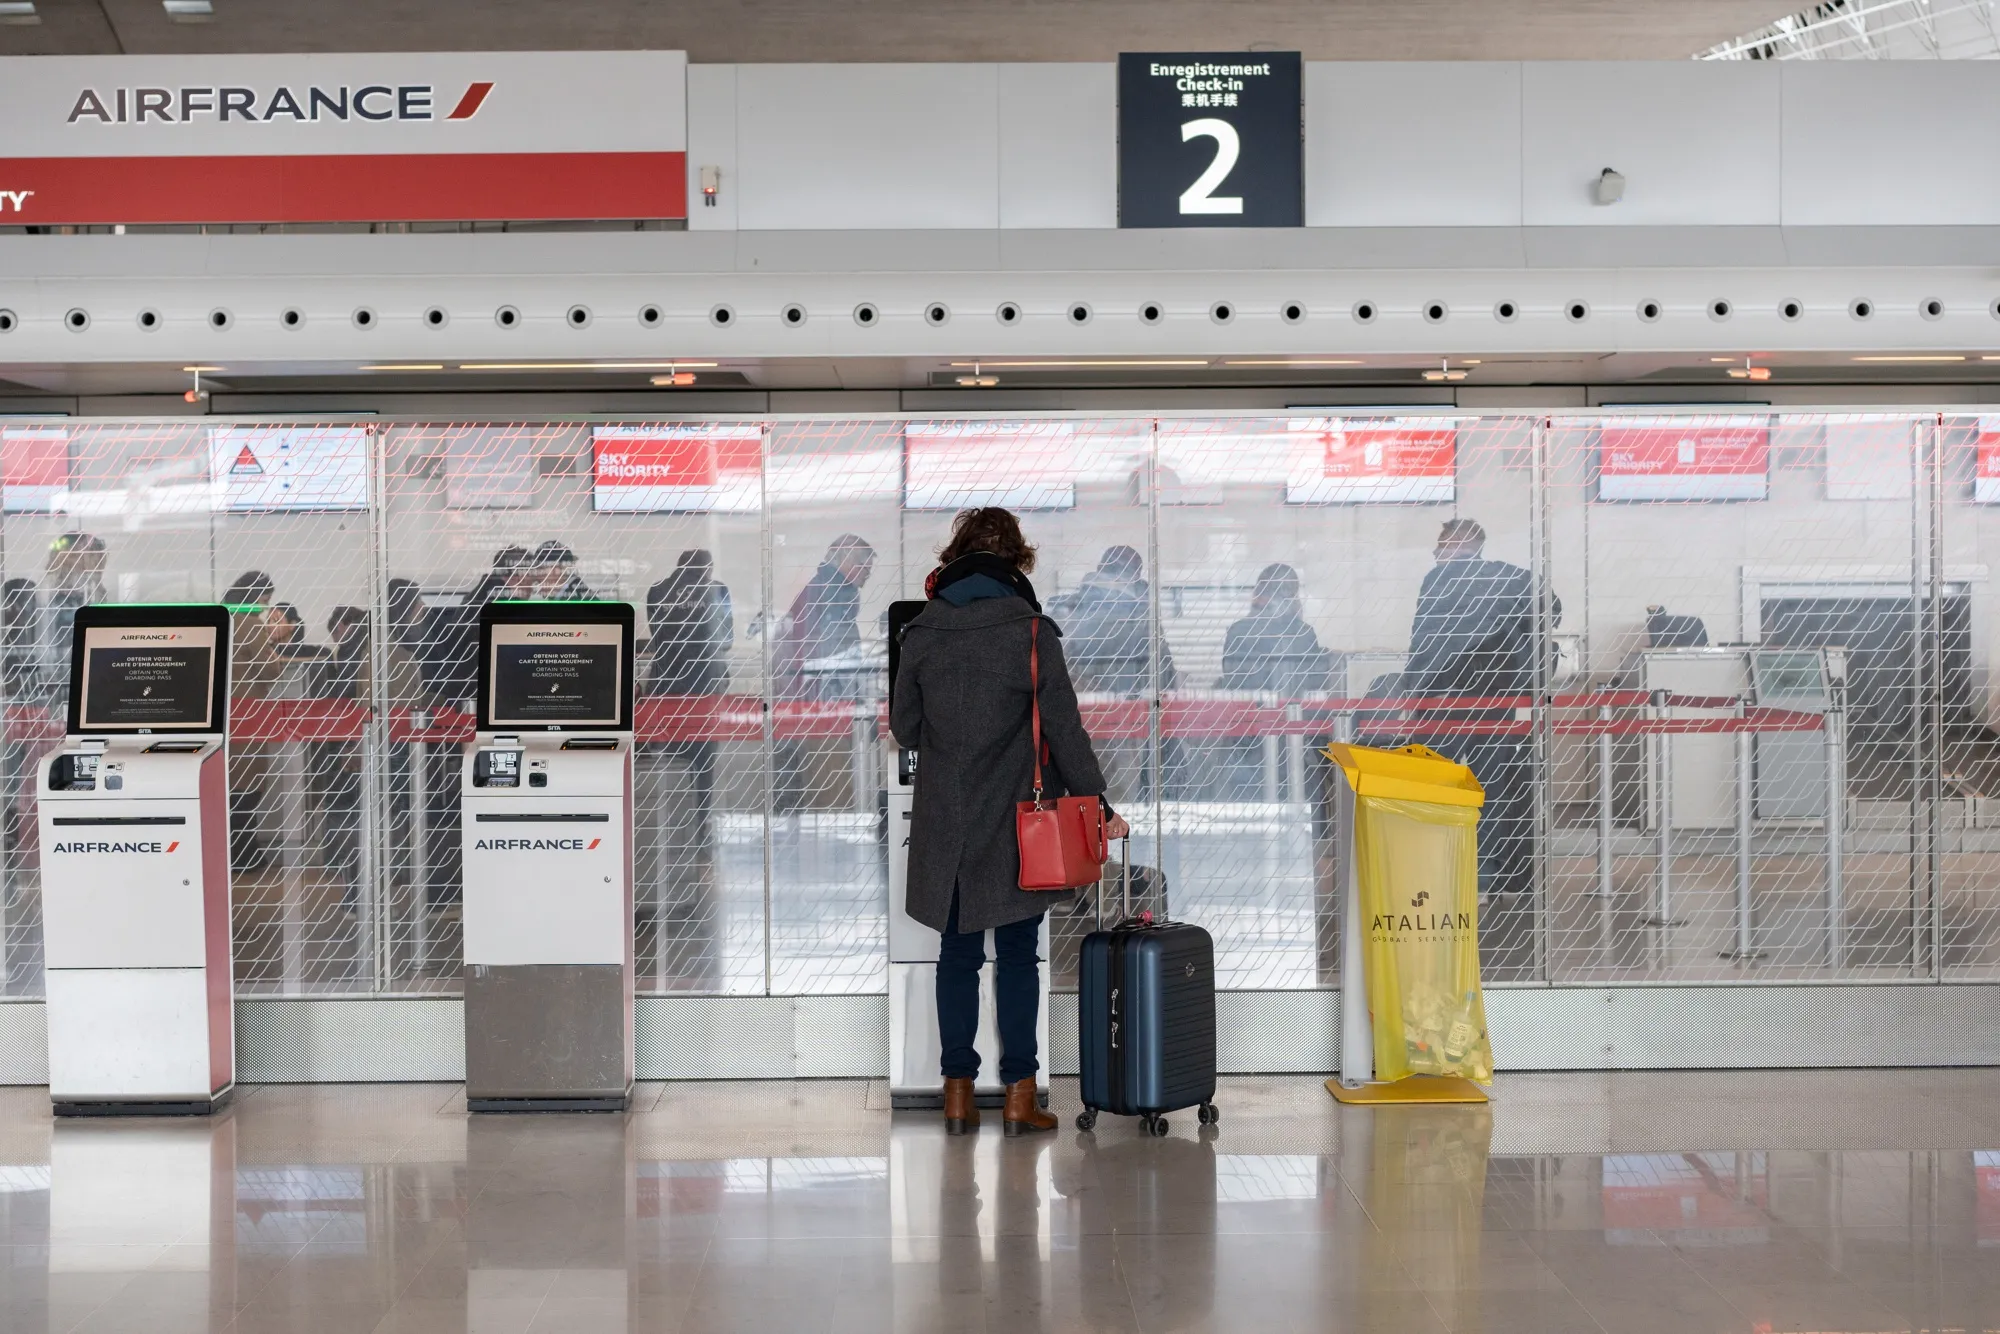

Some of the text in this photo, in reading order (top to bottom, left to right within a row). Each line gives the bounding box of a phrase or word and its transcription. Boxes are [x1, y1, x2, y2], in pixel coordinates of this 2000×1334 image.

[1150, 63, 1270, 78] Enregistrement
[1176, 78, 1243, 91] Check-in
[67, 86, 433, 124] AIRFRANCE
[1181, 93, 1238, 107] 乘机手续
[1179, 118, 1243, 214] 2
[598, 453, 629, 465] SKY
[1611, 461, 1664, 470] PRIORITY
[598, 465, 671, 478] PRIORITY
[53, 842, 162, 853] AIRFRANCE
[475, 838, 583, 850] AIRFRANCE
[1372, 913, 1470, 931] ATALIAN
[1418, 935, 1471, 943] SERVICES
